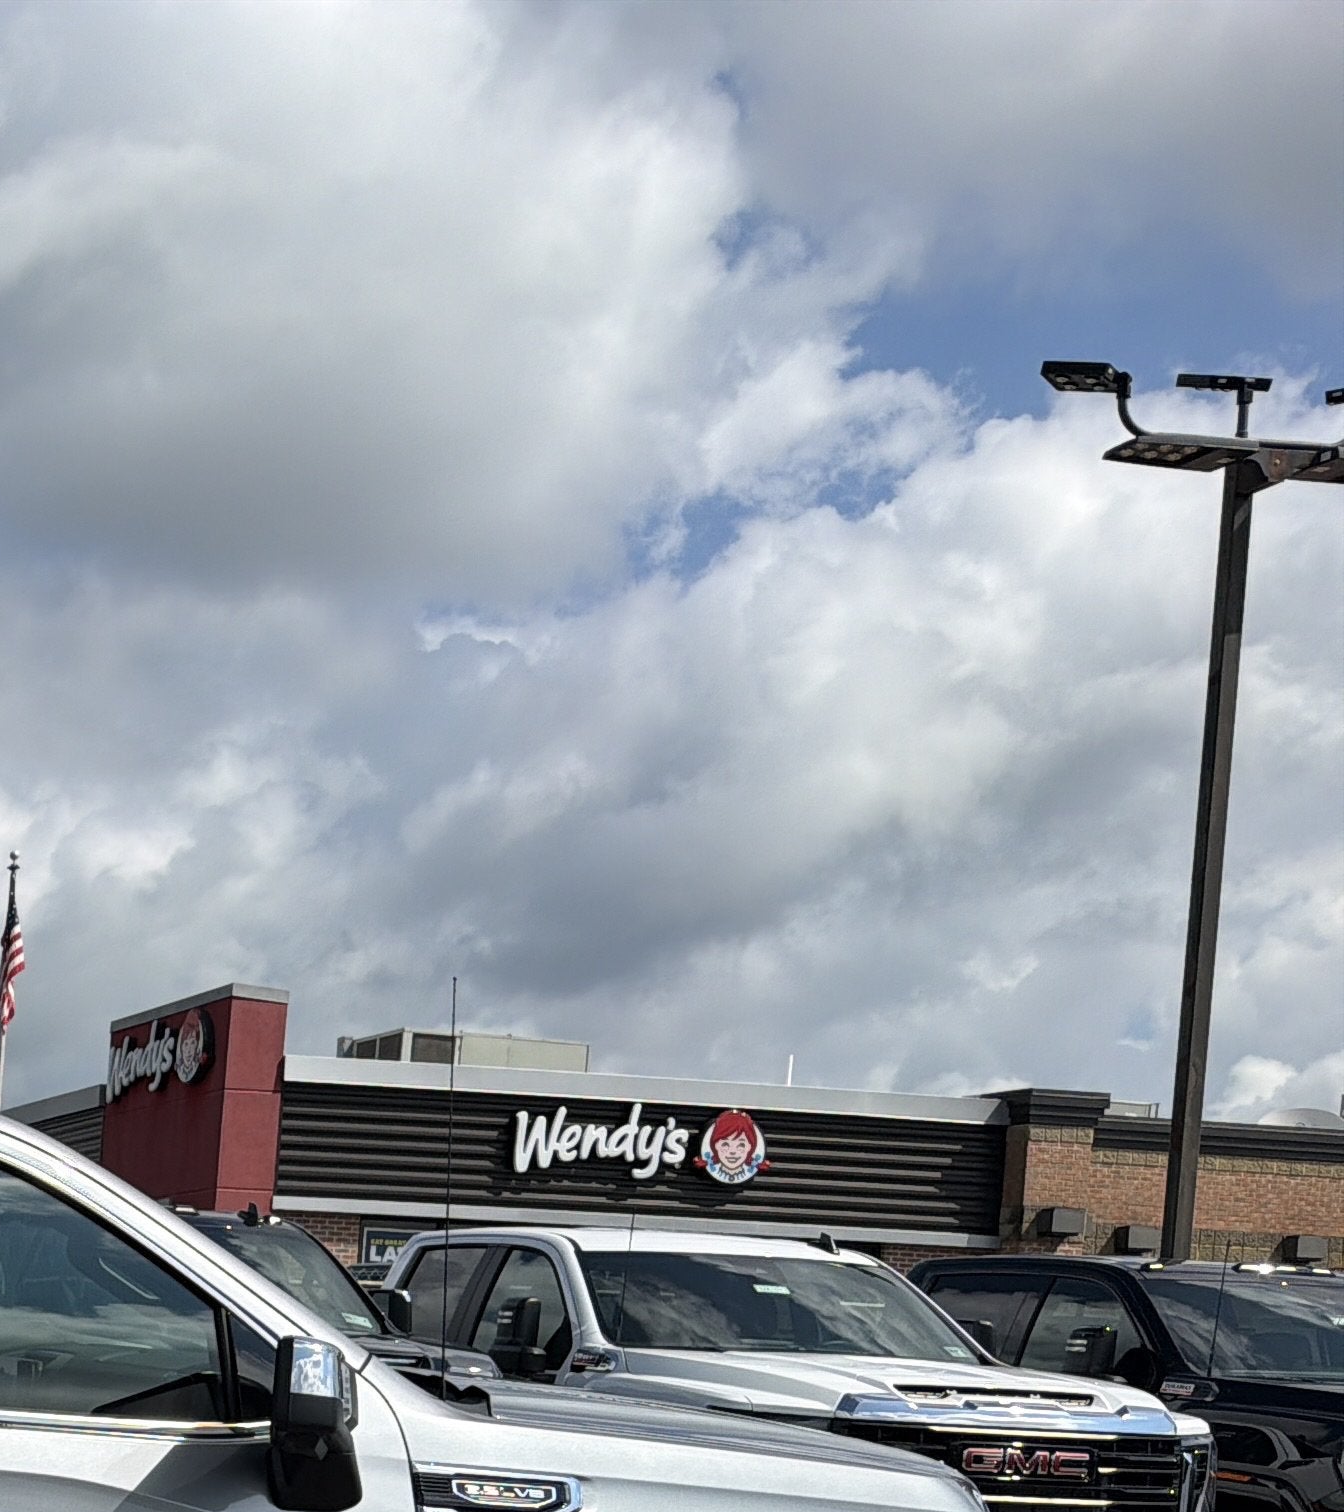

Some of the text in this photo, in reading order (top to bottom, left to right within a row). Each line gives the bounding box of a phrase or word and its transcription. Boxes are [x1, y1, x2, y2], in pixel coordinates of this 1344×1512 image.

[106, 1019, 175, 1104] Wendy's
[513, 1102, 689, 1179] Wendy's
[962, 1447, 1090, 1476] GMC
